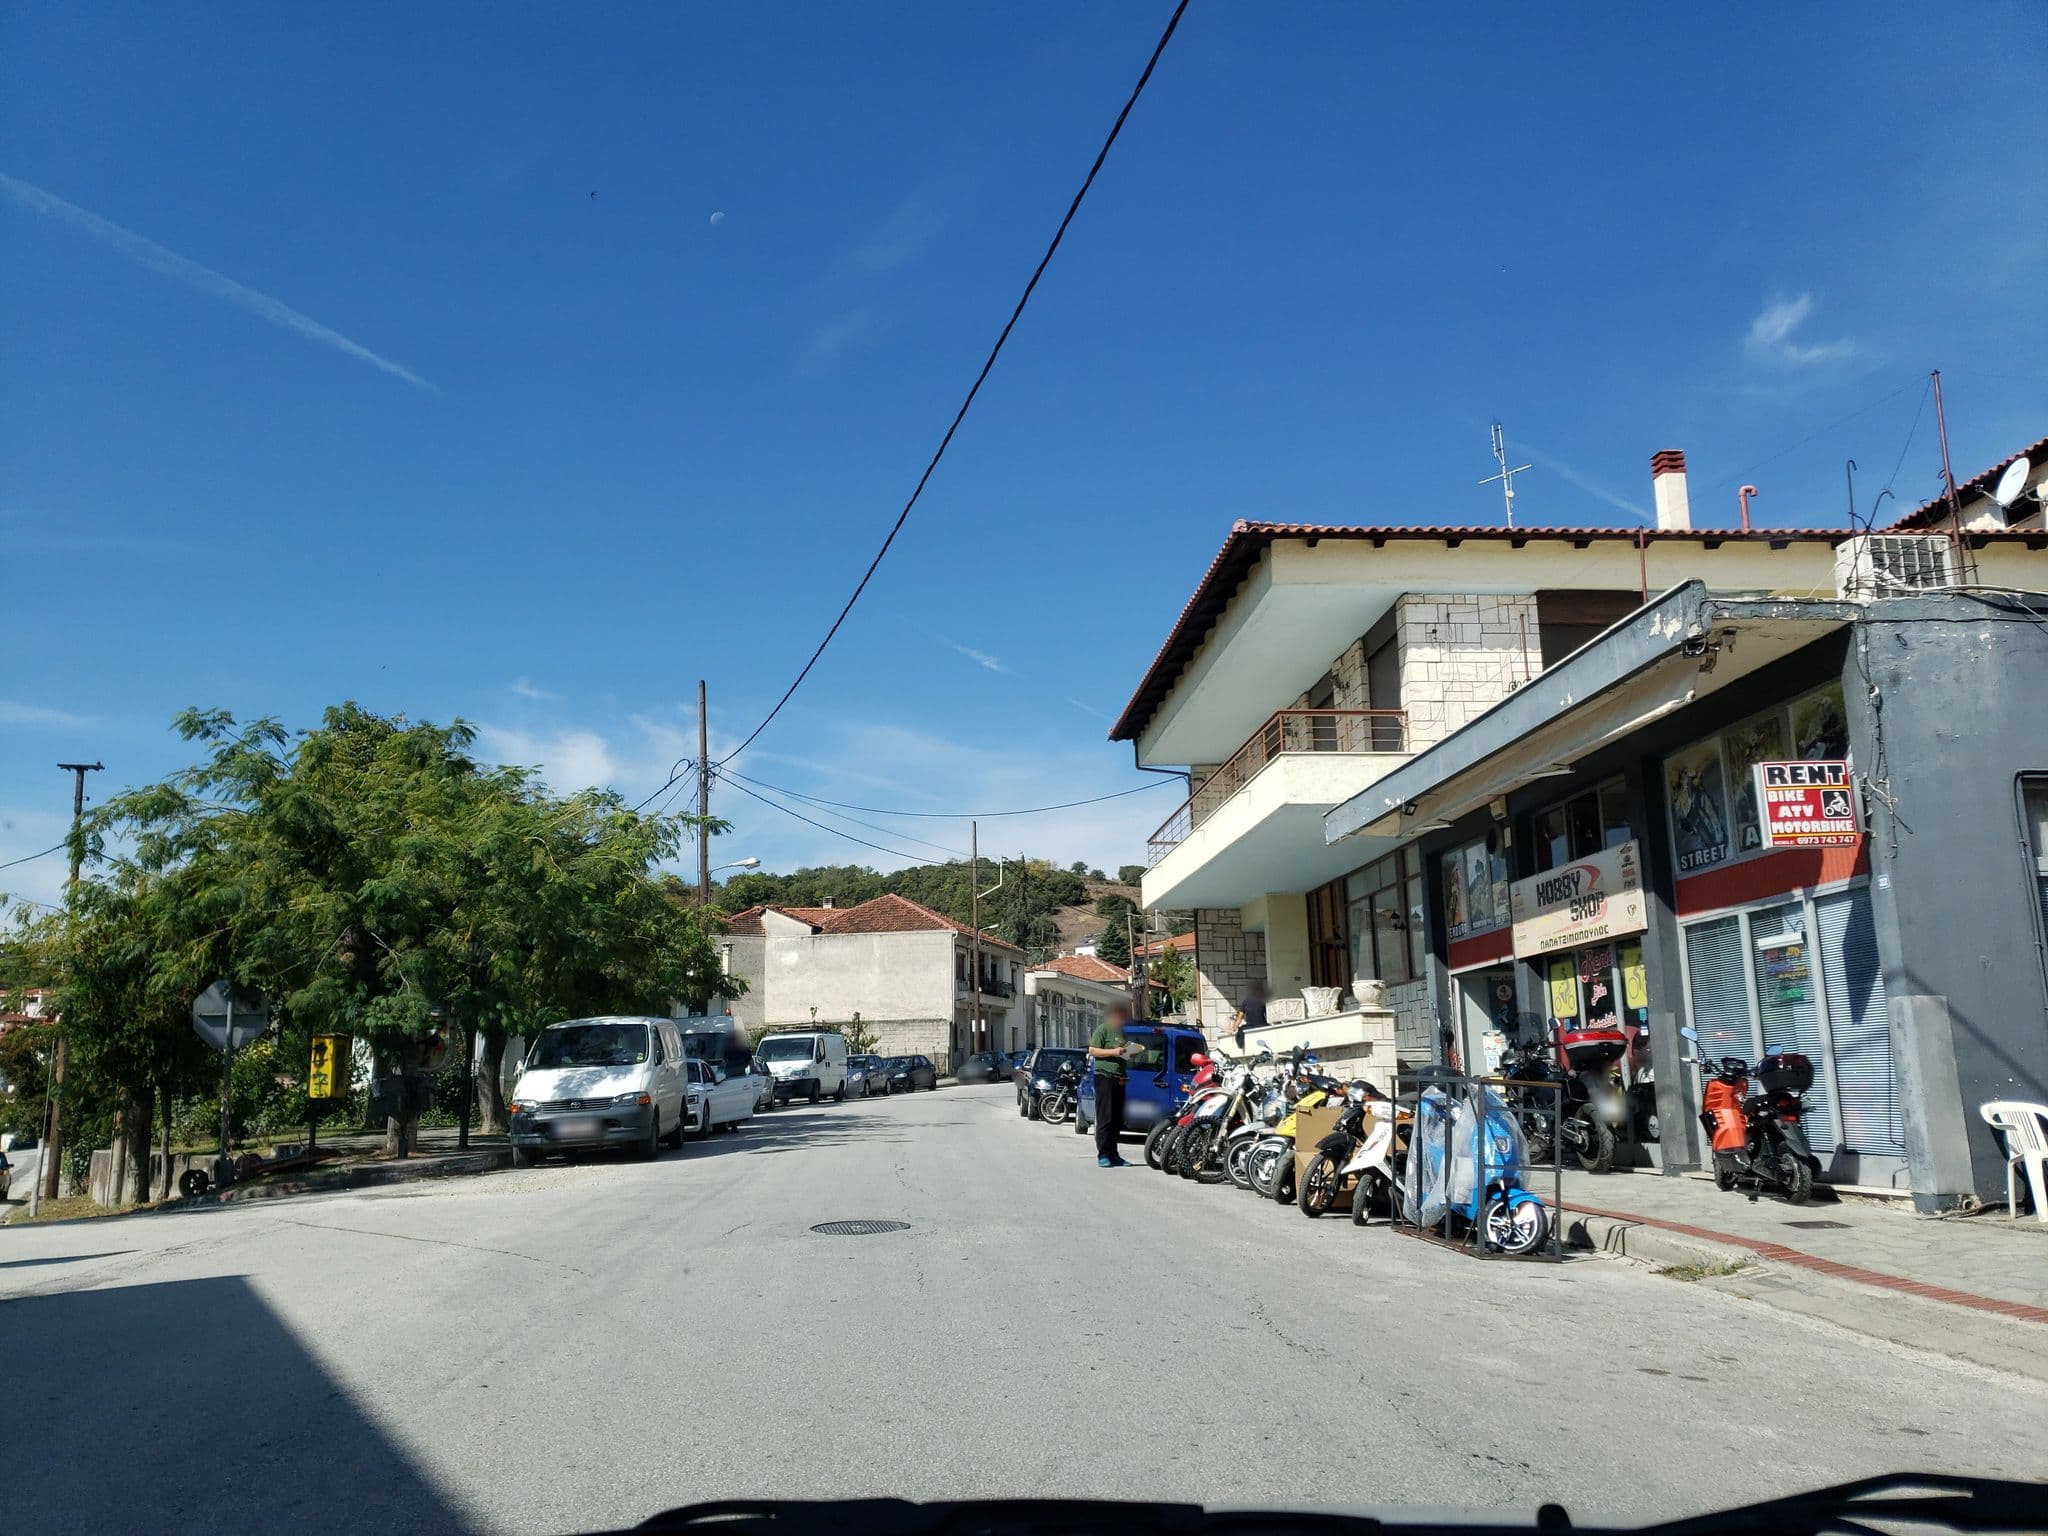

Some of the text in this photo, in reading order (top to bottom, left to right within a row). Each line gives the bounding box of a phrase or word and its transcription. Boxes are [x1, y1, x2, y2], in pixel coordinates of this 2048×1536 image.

[1764, 763, 1846, 787] RENT
[1767, 789, 1806, 802] BIKE
[1778, 804, 1814, 818] ATV
[1771, 820, 1854, 834] MOTORBIKE
[1797, 836, 1819, 845] 6973
[1838, 835, 1855, 844] 747
[1681, 844, 1726, 869] STREET
[1536, 870, 1581, 907] HOBBY
[1570, 890, 1605, 922] SHOP
